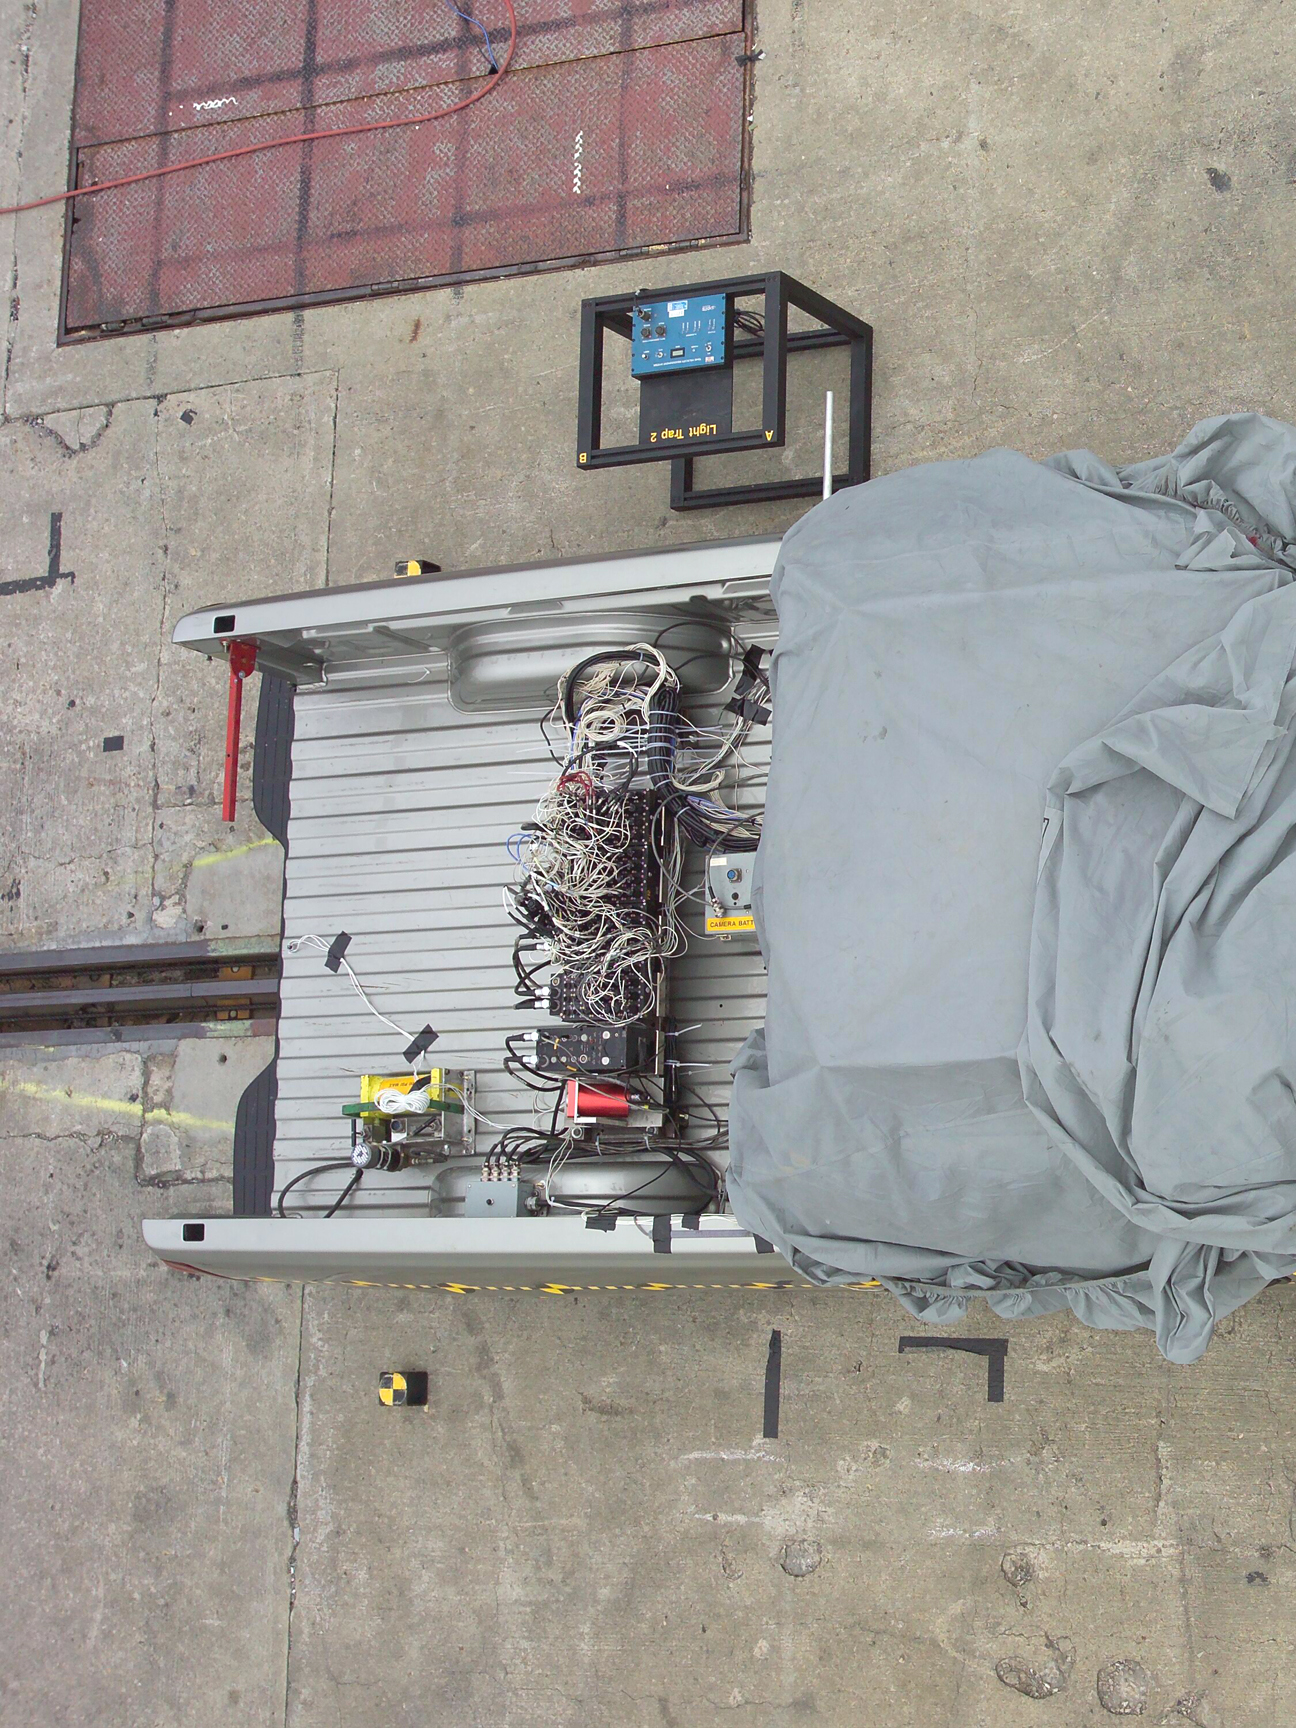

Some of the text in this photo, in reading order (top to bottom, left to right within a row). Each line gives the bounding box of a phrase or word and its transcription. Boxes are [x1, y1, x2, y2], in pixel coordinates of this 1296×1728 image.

[650, 423, 717, 442] Light Trap 2
[765, 430, 774, 441] A
[579, 453, 587, 463] B
